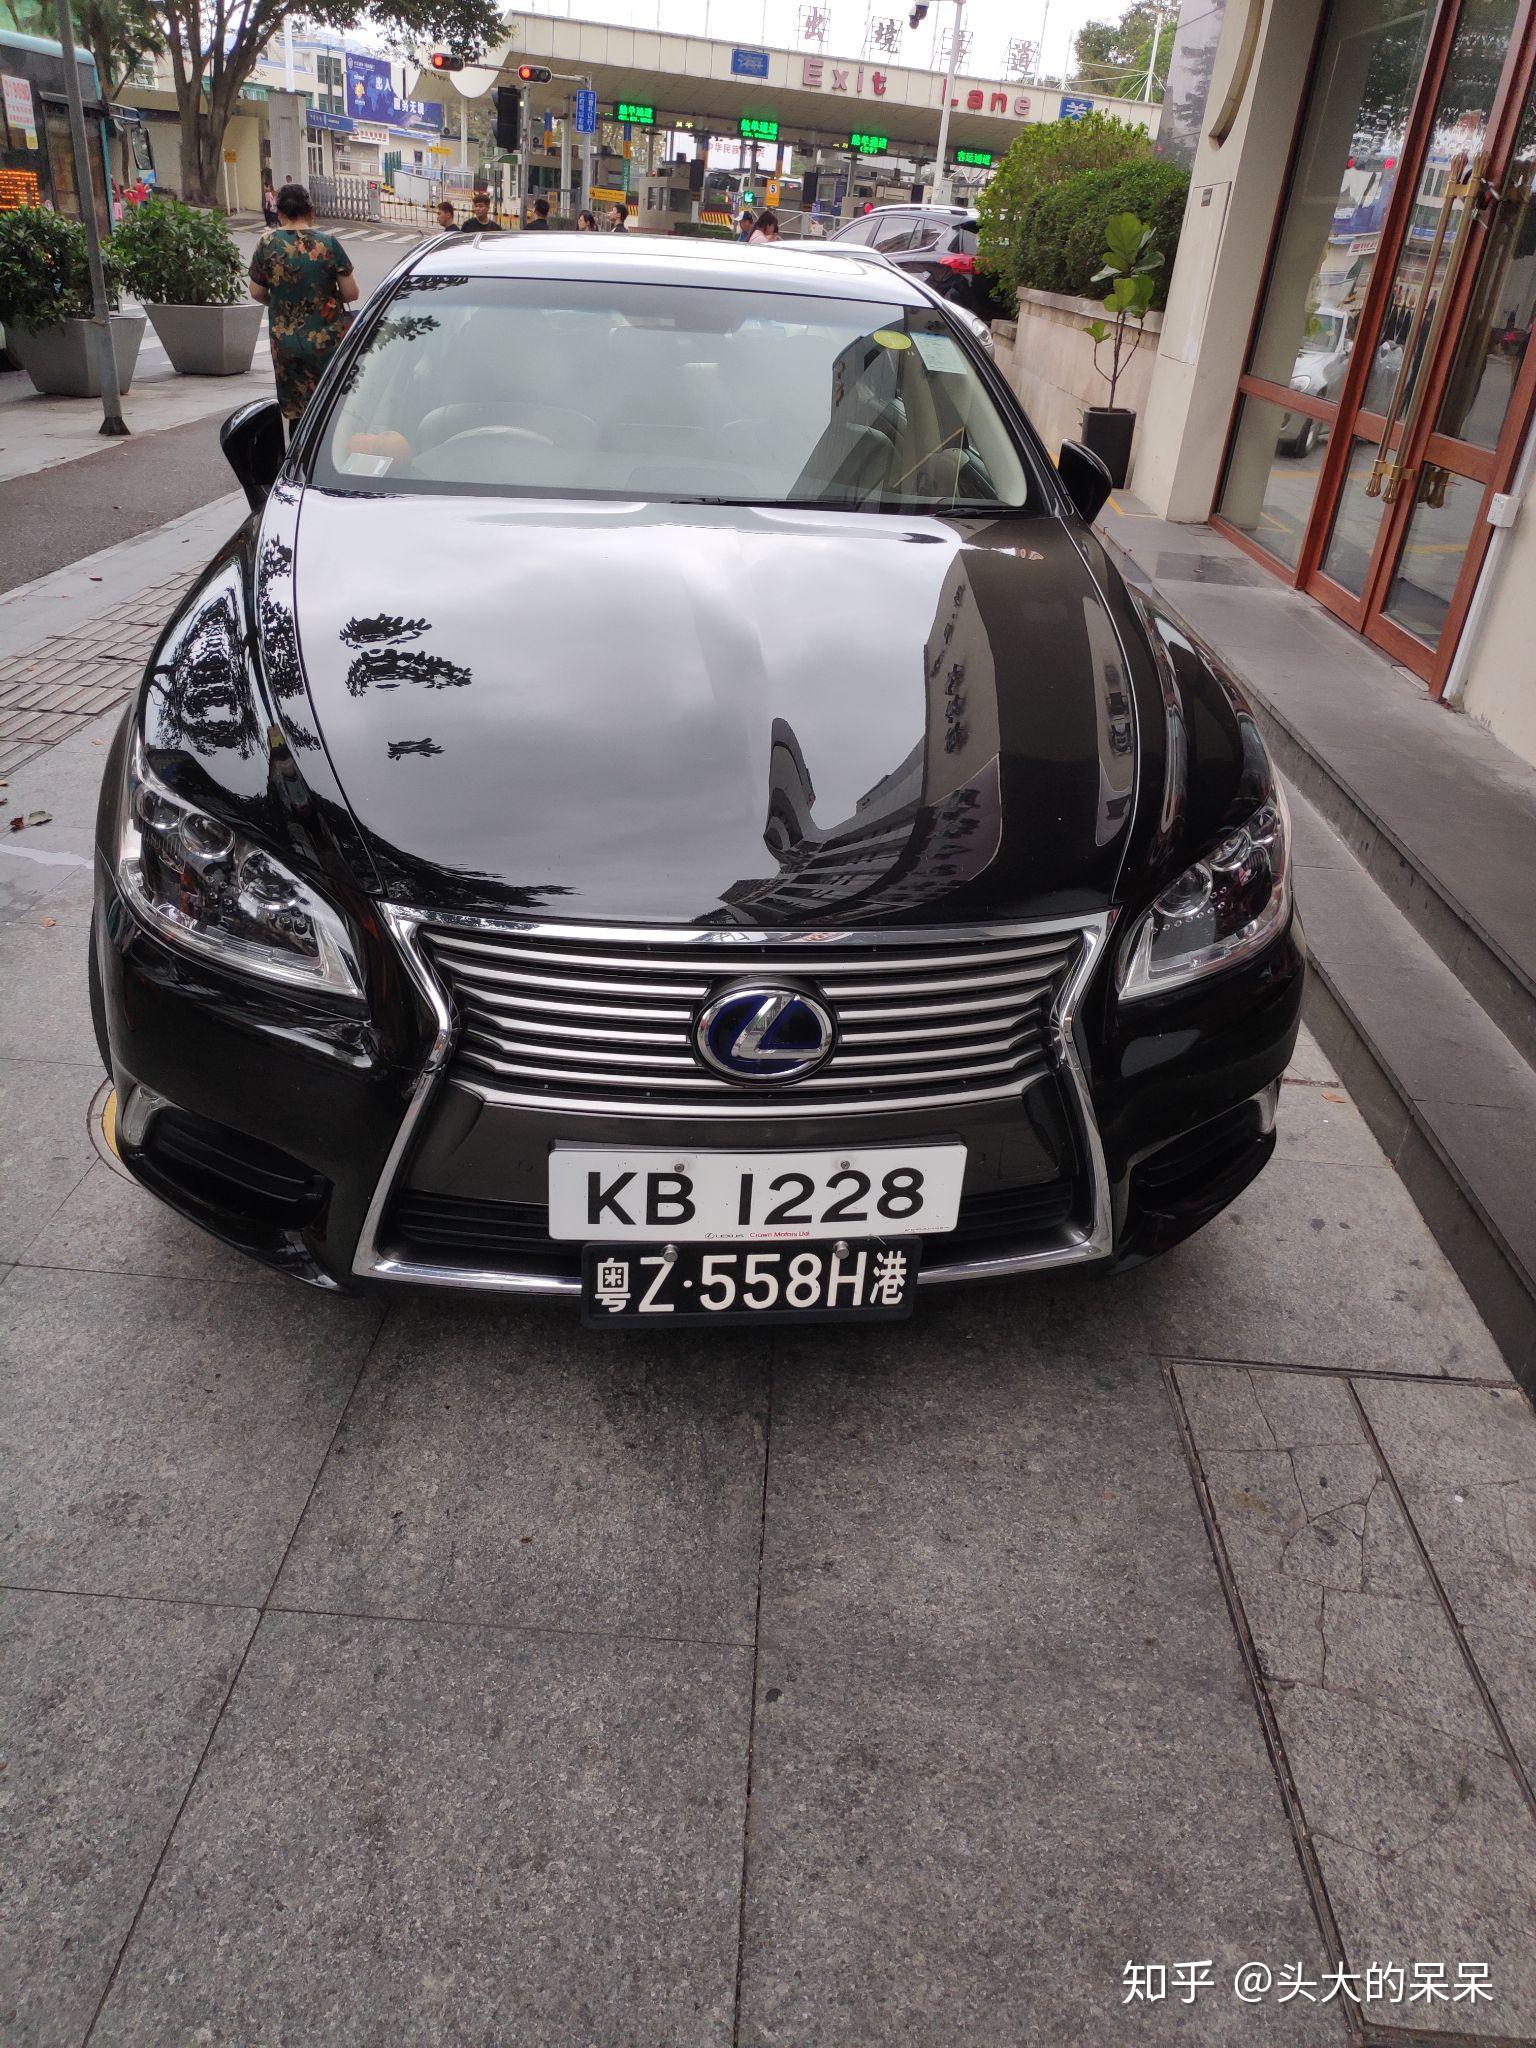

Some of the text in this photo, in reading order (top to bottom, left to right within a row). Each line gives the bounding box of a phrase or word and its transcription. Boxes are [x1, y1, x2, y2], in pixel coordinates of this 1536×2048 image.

[802, 57, 1032, 116] Exit Lane
[586, 1167, 925, 1226] KB 1228
